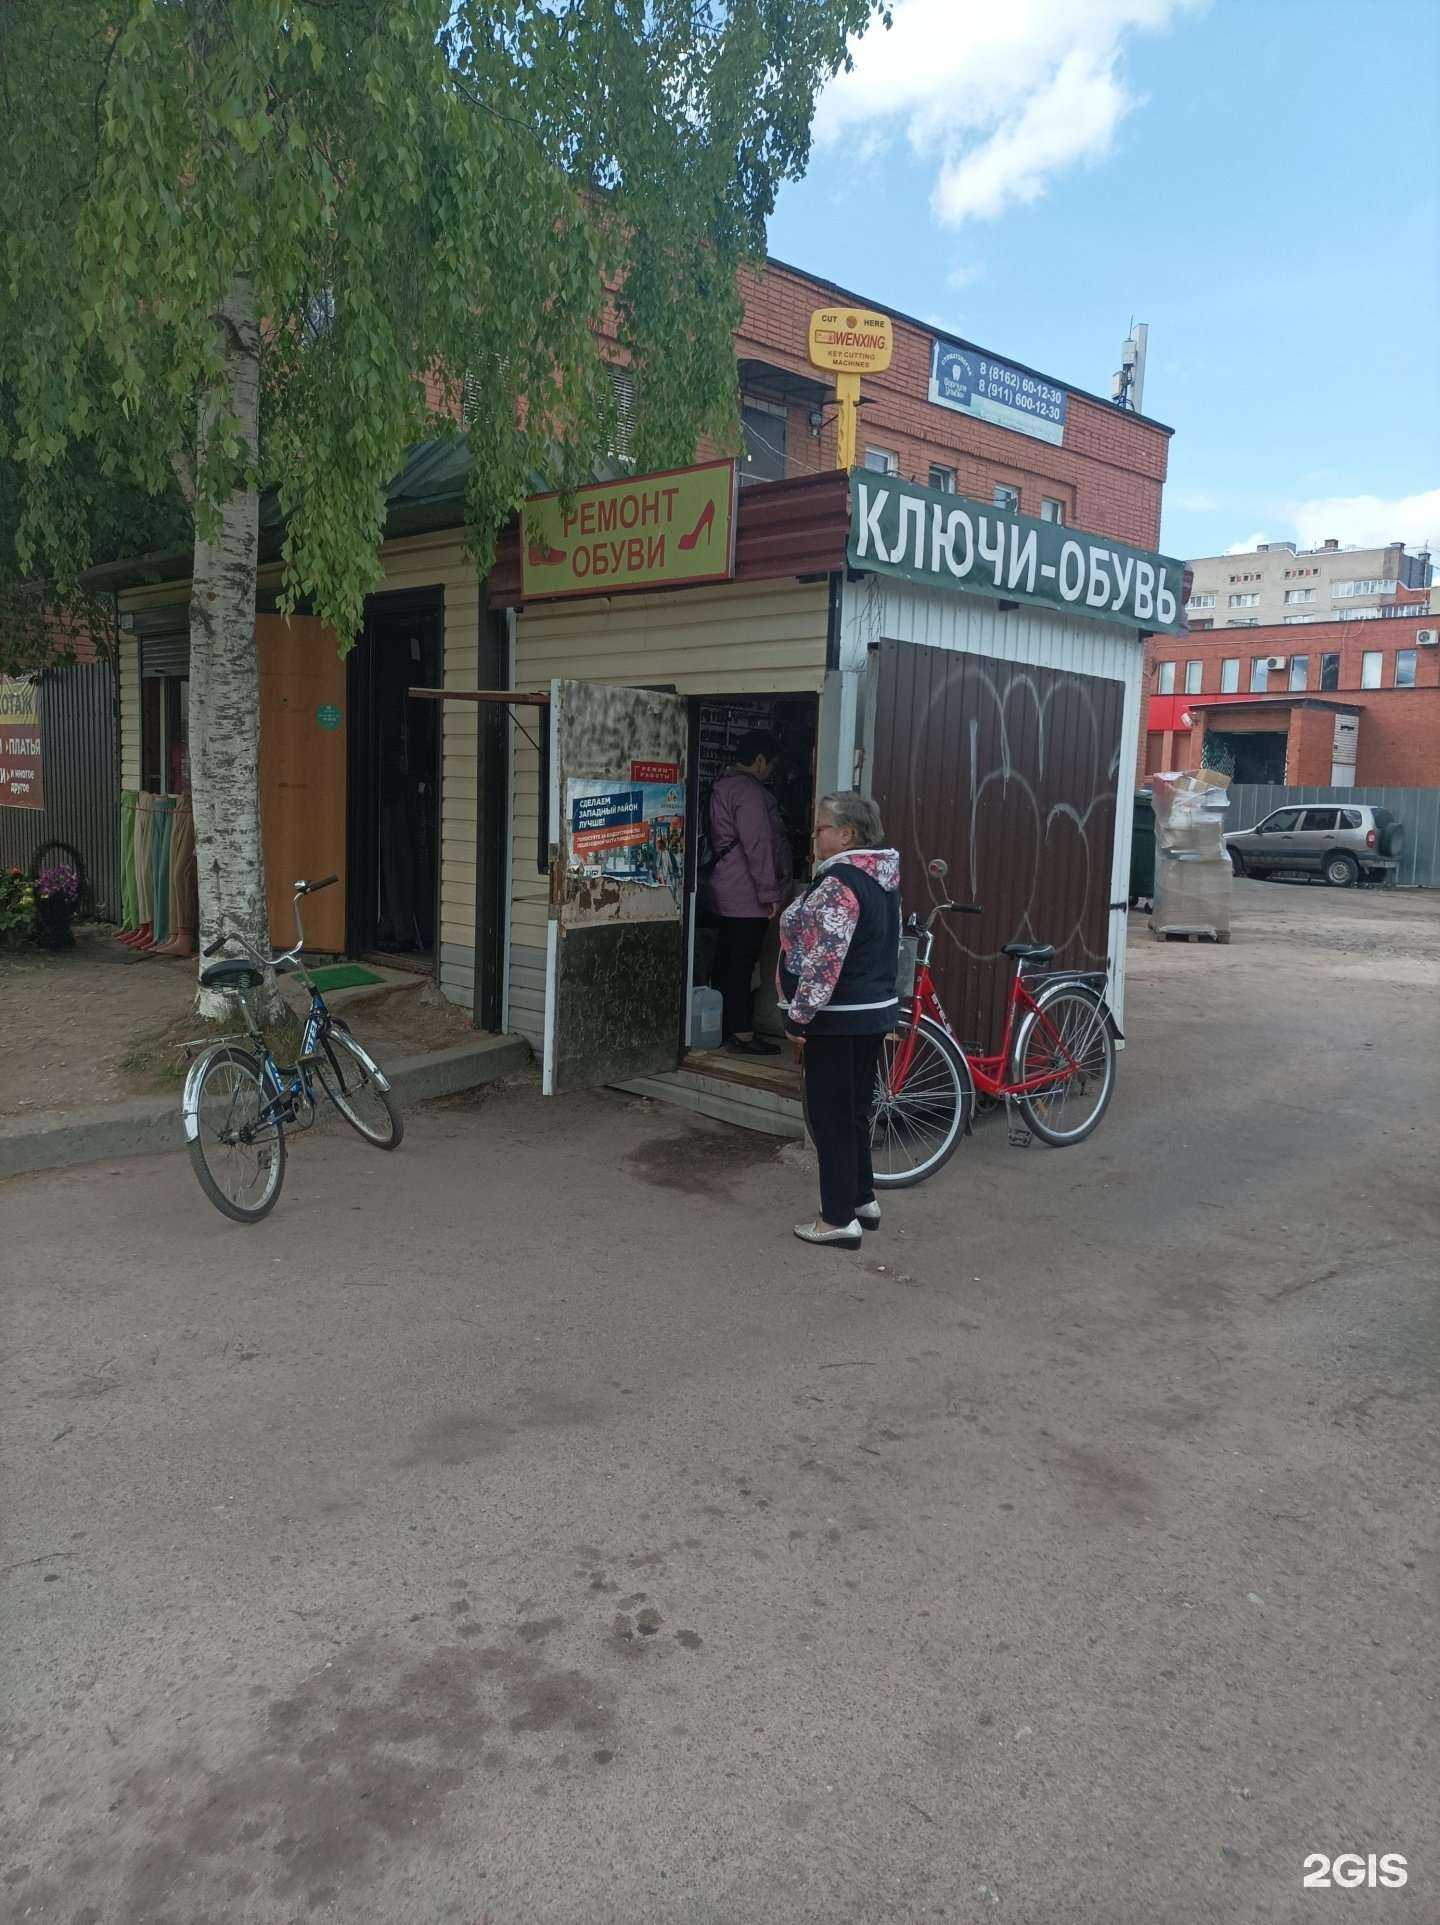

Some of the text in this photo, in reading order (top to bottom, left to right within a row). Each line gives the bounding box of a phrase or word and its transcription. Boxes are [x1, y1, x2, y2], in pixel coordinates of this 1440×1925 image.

[821, 314, 885, 328] CUT HERE
[834, 330, 886, 350] WENXING
[832, 359, 870, 368] MACHINES
[843, 351, 876, 361] CUTTING
[980, 362, 987, 375] 8
[989, 365, 1020, 391] (8162)
[1022, 378, 1062, 405] 60-12-30
[978, 378, 986, 392] 8
[987, 382, 1013, 406] (911)
[1015, 392, 1060, 420] 600-12-30
[563, 487, 680, 538] РЕМОНТ
[572, 533, 666, 578] ОБУВИ
[856, 483, 1177, 625] КЛЮЧИ-ОБУВЬ
[9, 738, 40, 755] ПЛАТЬЯ
[578, 801, 638, 818] ЗАПАДНЫЙ РАЙОН
[579, 797, 611, 809] СДЕЛАЕМ
[578, 818, 606, 830] ЛУЧШЕ!
